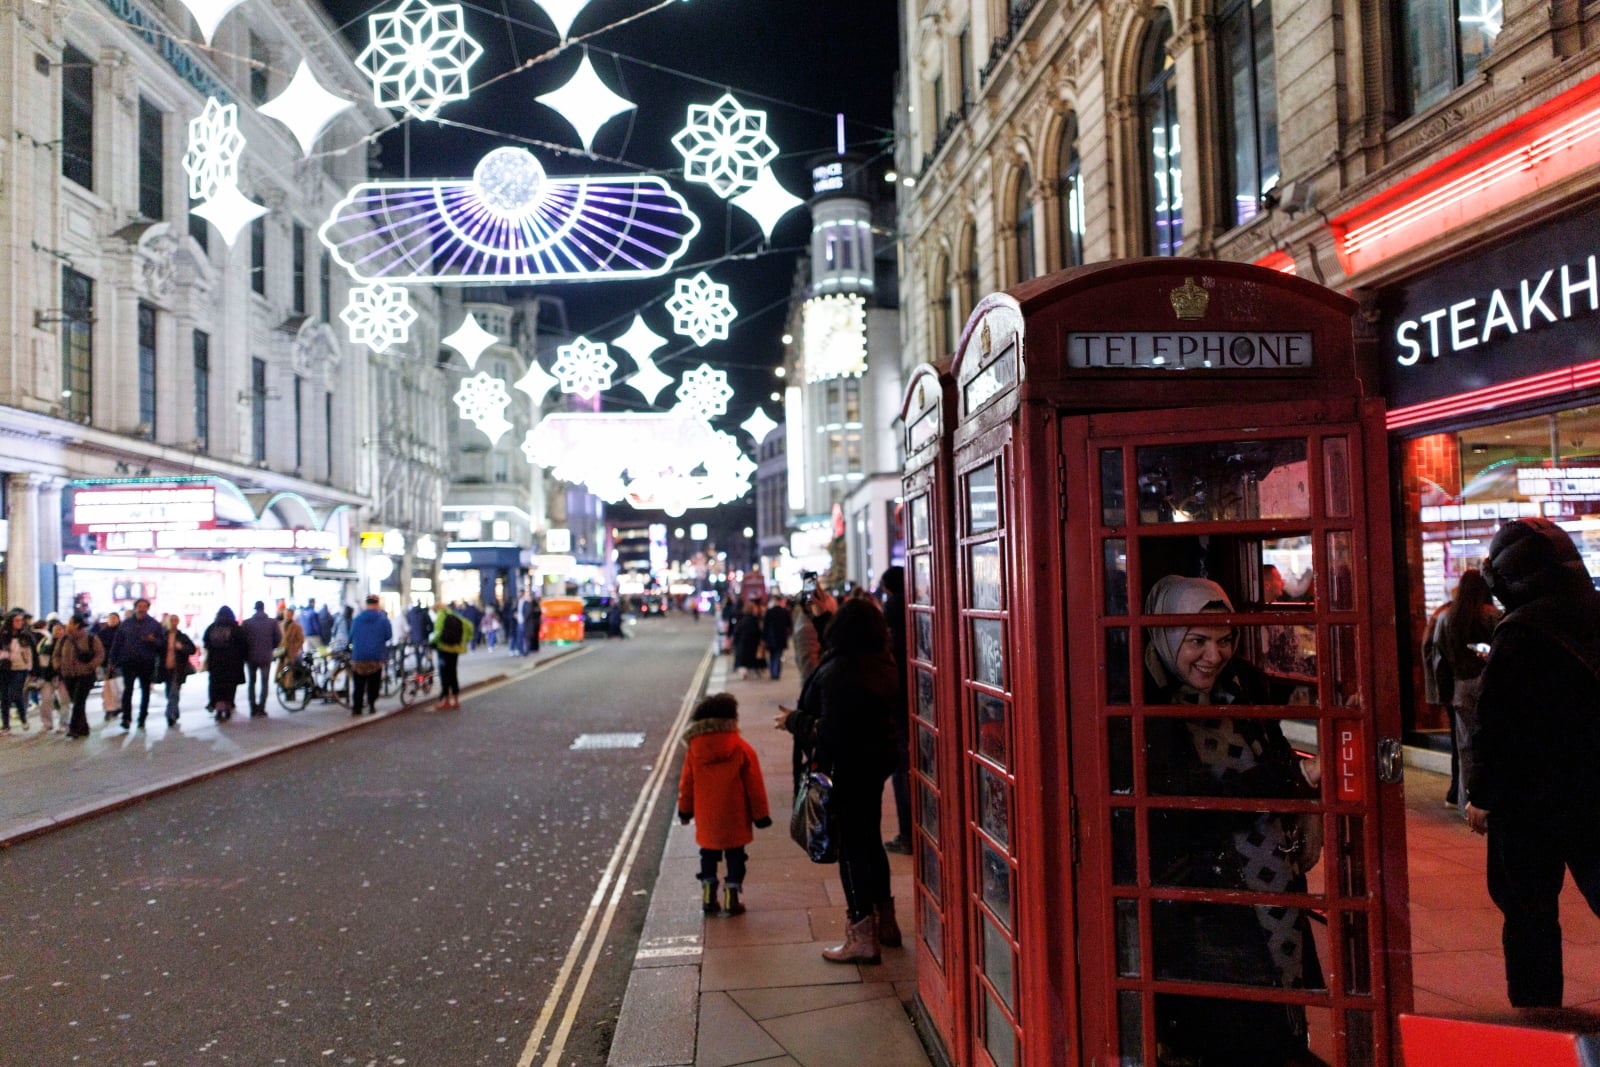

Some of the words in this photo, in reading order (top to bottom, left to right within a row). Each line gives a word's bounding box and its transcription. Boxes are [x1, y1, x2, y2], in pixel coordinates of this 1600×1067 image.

[1396, 255, 1599, 366] STEAKH
[1075, 336, 1304, 366] TELEPHONE
[1341, 731, 1355, 793] PULL
